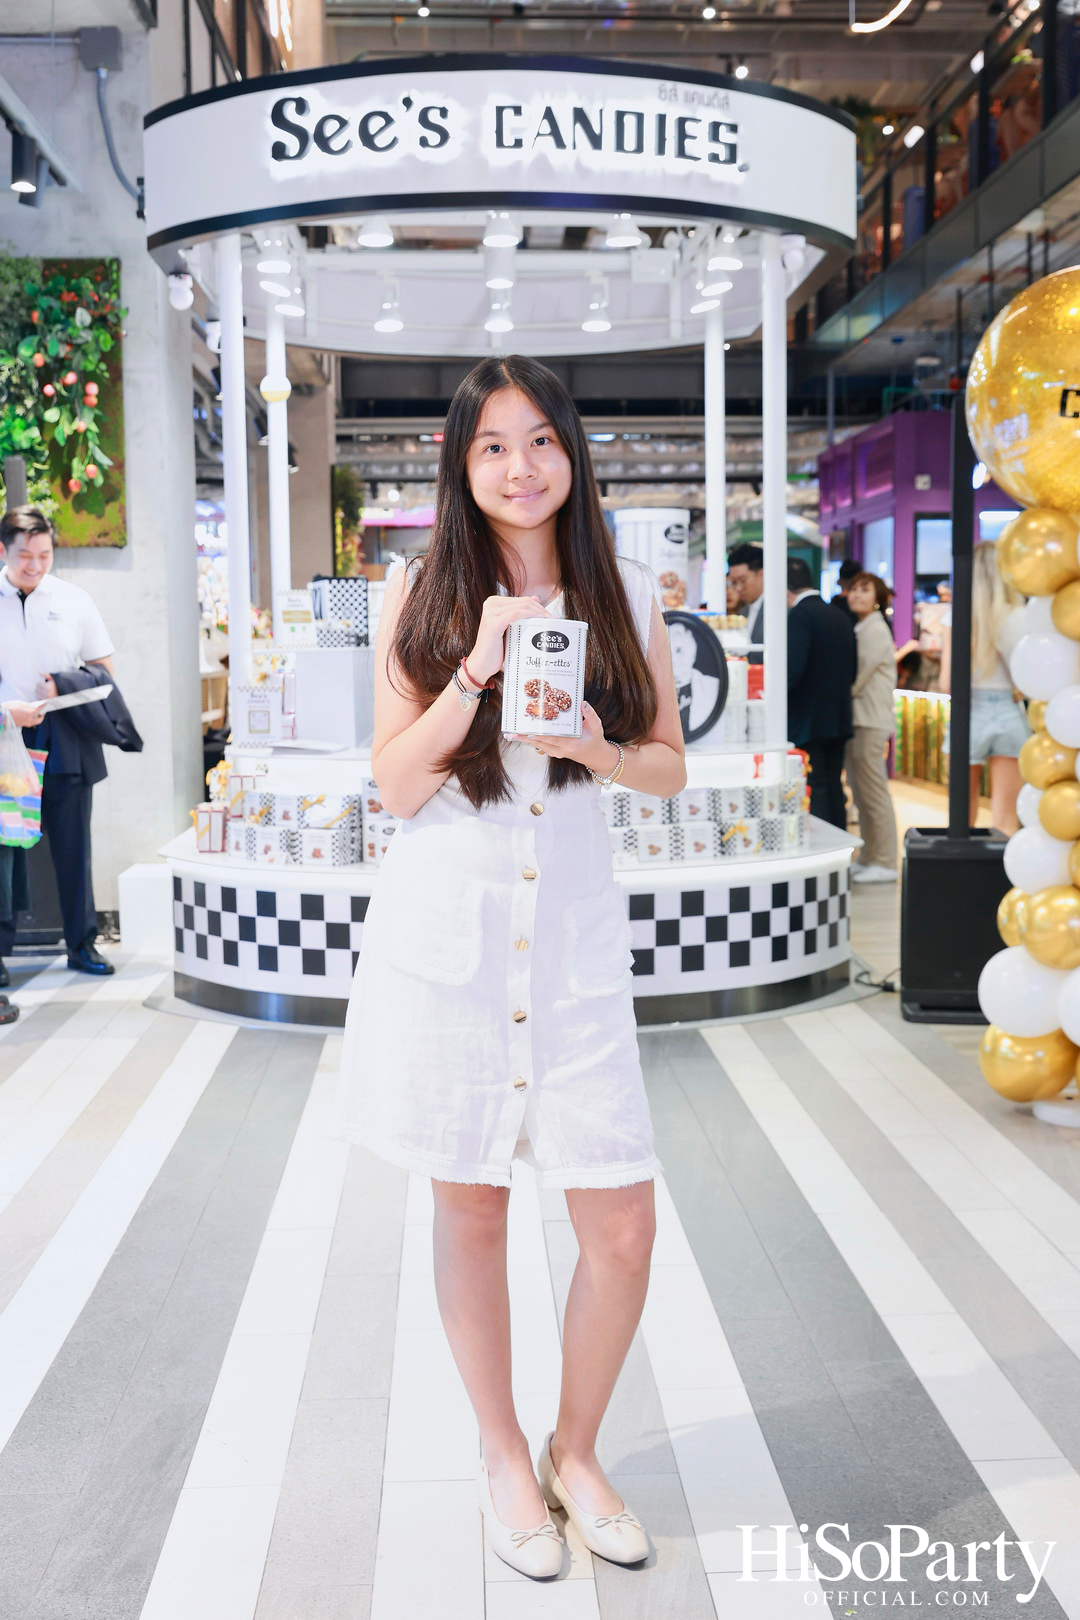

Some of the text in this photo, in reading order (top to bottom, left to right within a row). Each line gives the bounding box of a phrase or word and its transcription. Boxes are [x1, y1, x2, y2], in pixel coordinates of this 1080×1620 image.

[271, 96, 738, 166] See's CANDIES
[540, 632, 562, 643] See's
